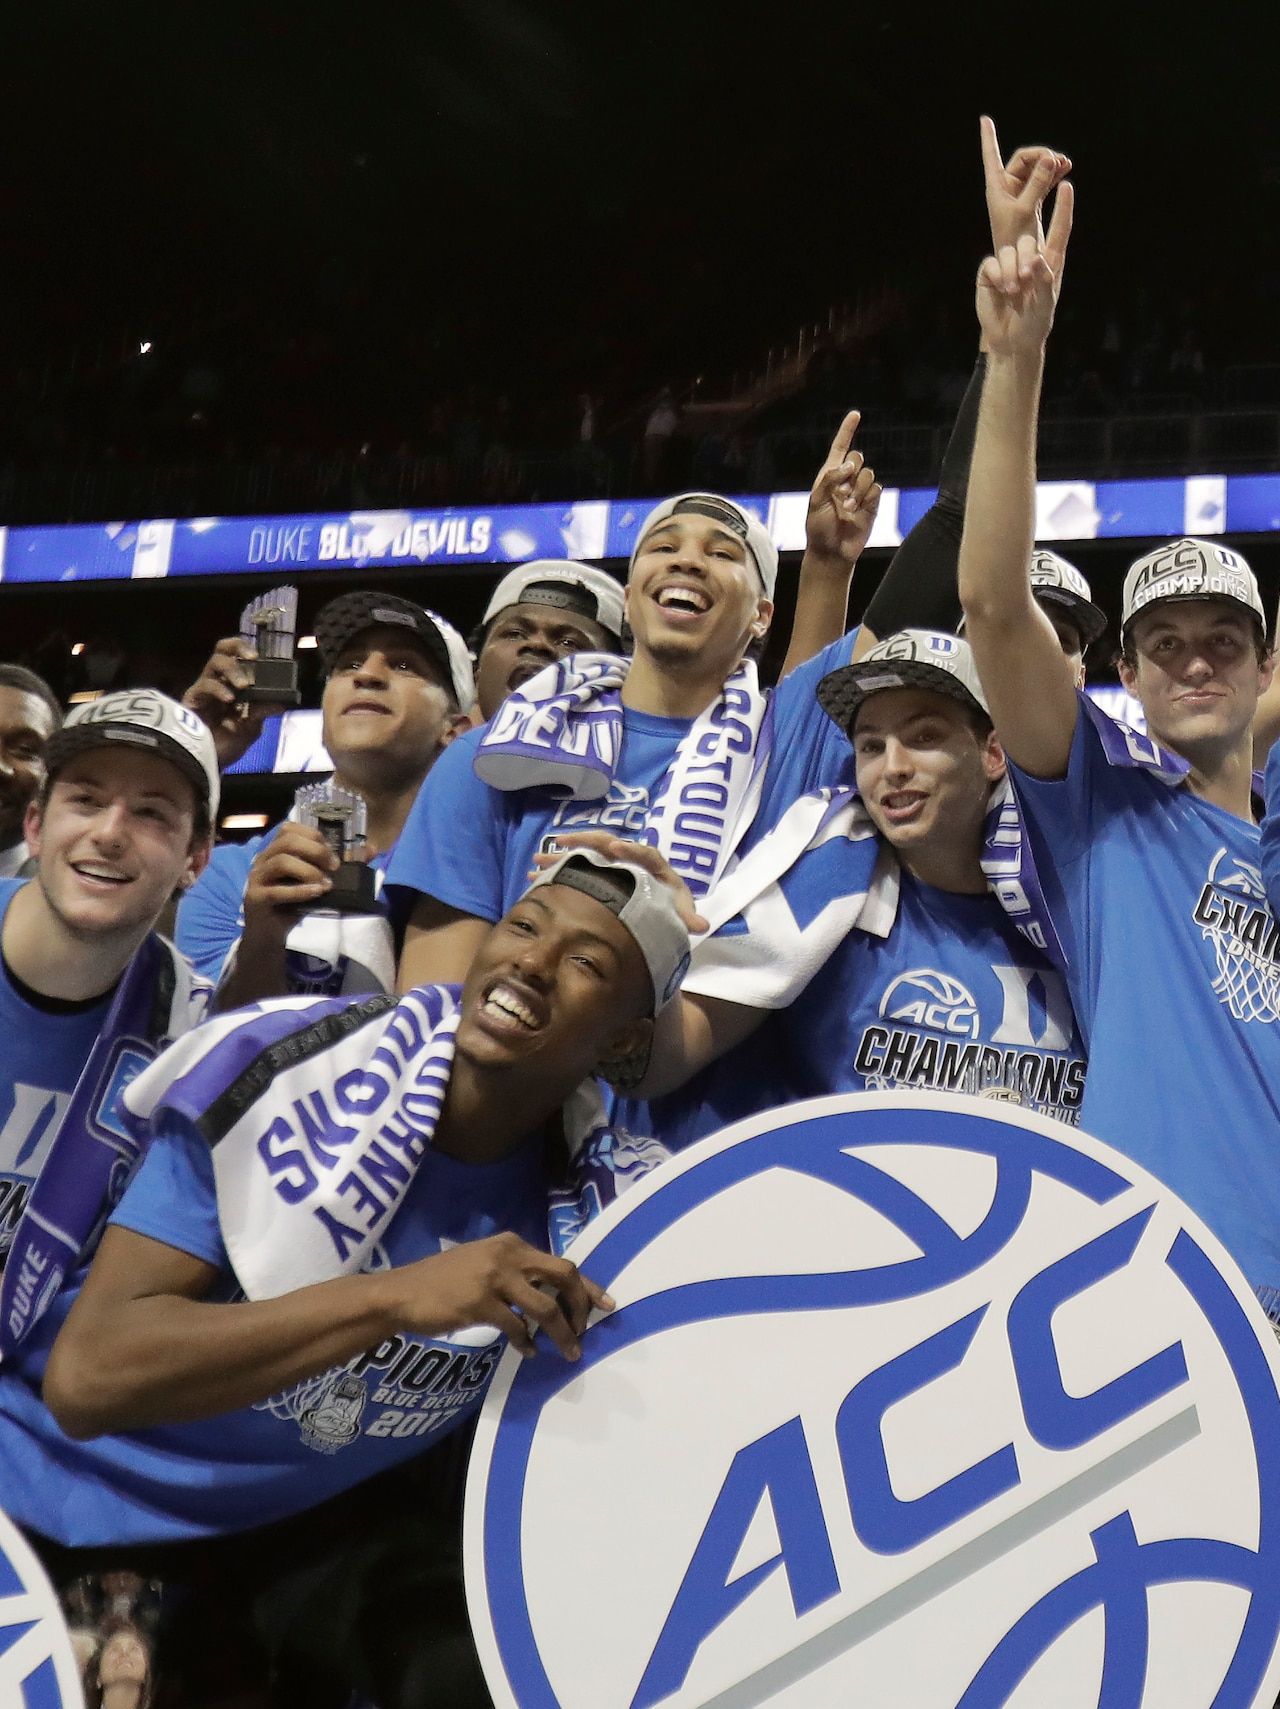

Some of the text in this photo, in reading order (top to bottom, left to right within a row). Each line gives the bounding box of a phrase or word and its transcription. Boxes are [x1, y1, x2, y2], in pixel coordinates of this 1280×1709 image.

[247, 524, 314, 564] DUKE
[391, 515, 492, 558] DEVILS
[1133, 546, 1199, 592] ACC
[1133, 574, 1249, 609] CHAMPIONS
[482, 697, 623, 778] DEVI
[889, 1000, 978, 1033] ACC
[7, 1242, 49, 1341] DUKE
[350, 1335, 503, 1398] PIONS
[371, 1387, 481, 1411] BLUE DEVILS
[364, 1407, 463, 1439] 2017
[630, 1200, 1194, 1709] ACC
